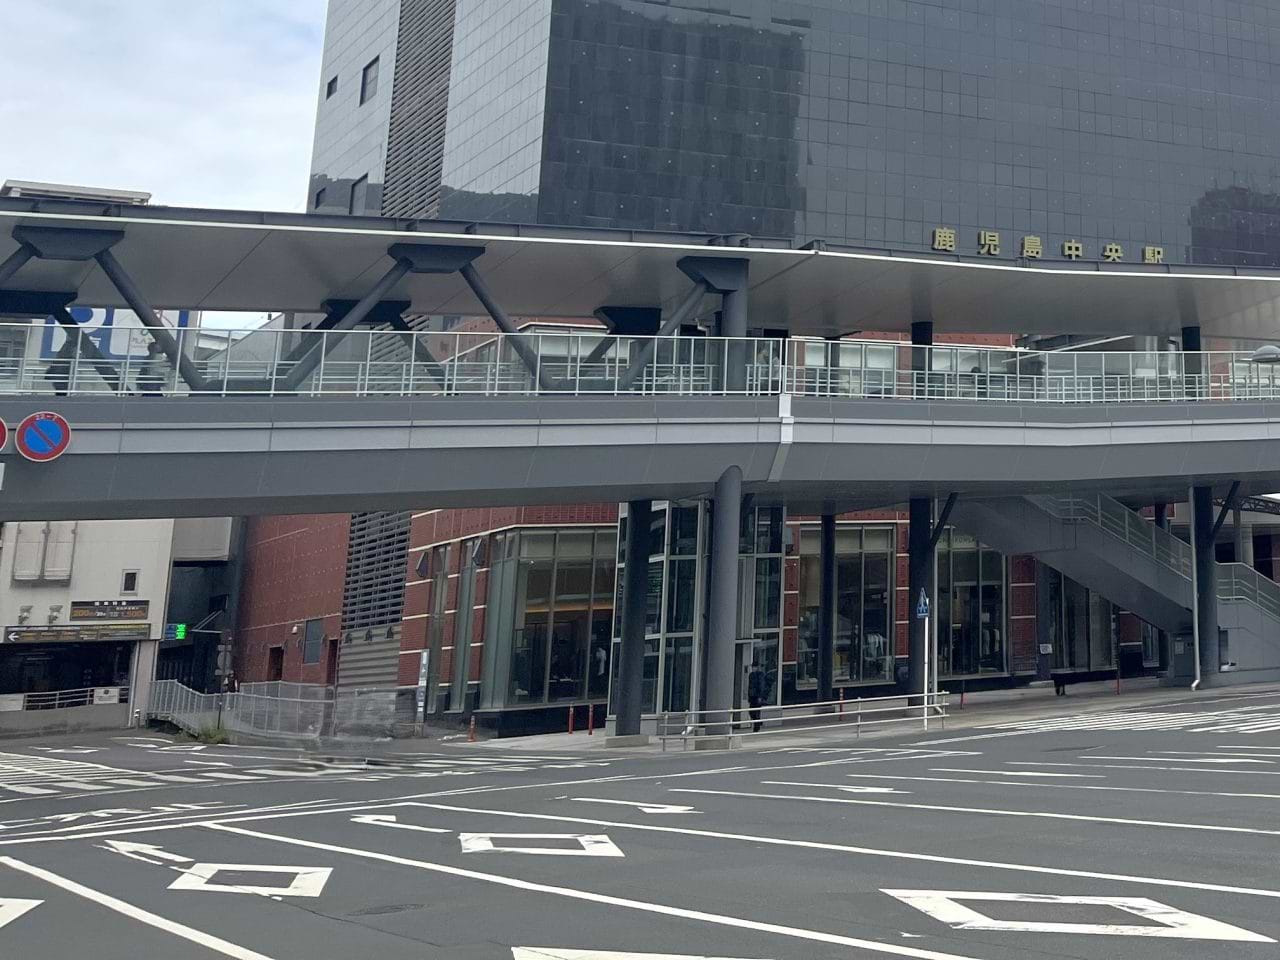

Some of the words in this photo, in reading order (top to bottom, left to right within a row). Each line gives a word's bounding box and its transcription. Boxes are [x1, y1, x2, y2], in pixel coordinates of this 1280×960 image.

[932, 227, 1164, 264] 鹿児島中央駅
